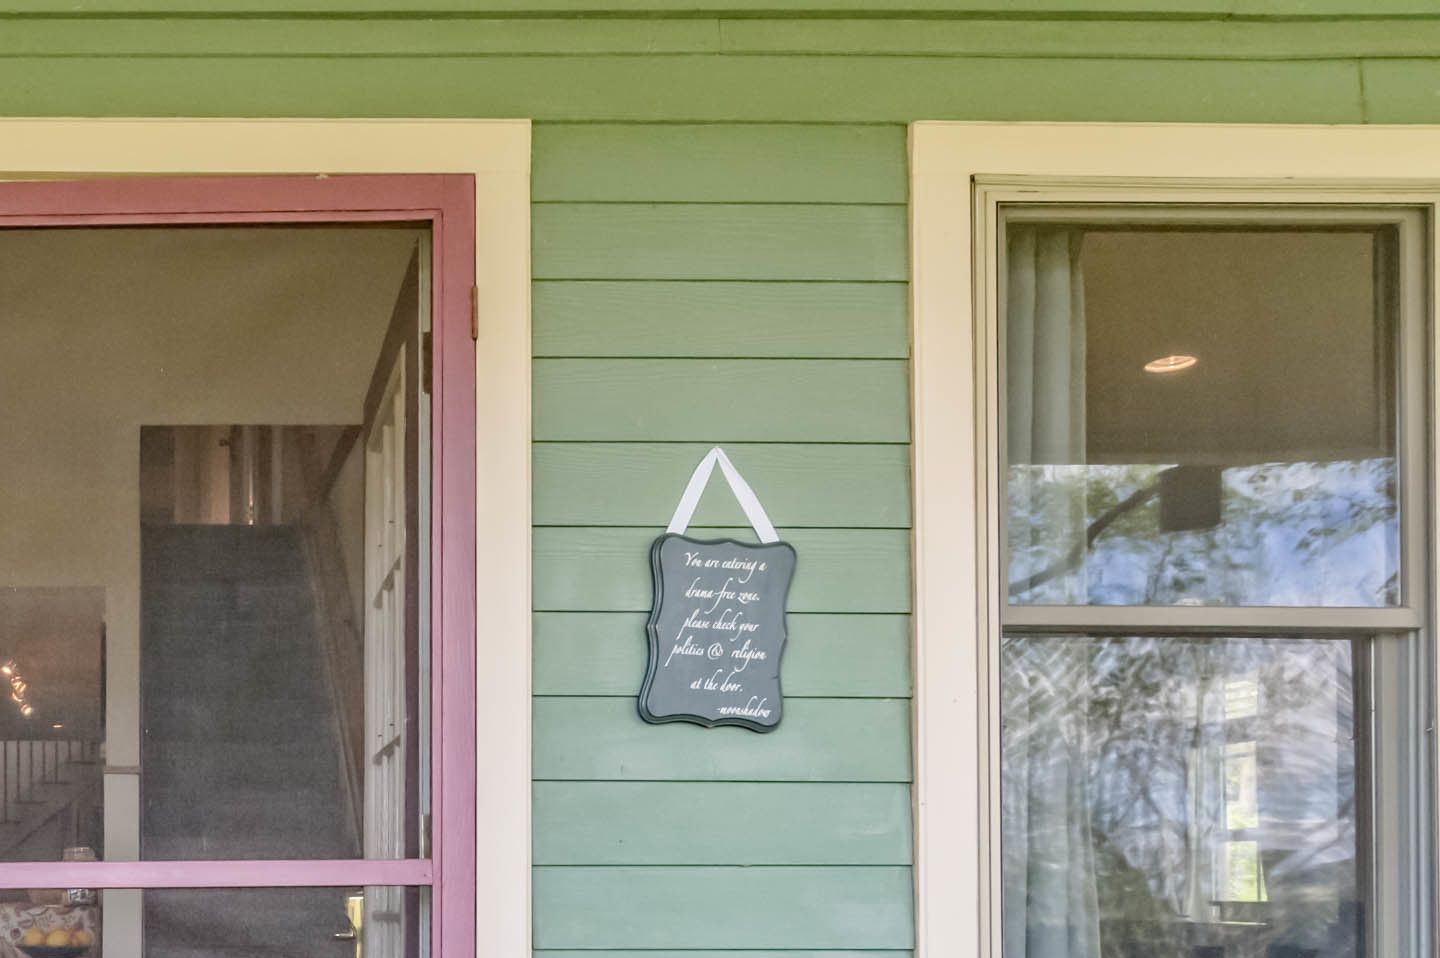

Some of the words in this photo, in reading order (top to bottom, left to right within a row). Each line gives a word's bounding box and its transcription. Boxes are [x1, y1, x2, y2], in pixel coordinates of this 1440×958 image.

[684, 552, 702, 567] You
[704, 560, 720, 568] are
[721, 558, 757, 583] entering
[759, 562, 768, 571] a
[685, 577, 736, 614] drama-free
[738, 592, 760, 604] zone.
[676, 608, 710, 639] please
[712, 608, 743, 630] check
[729, 623, 759, 641] your
[664, 635, 704, 667] politics
[707, 642, 724, 660] &
[731, 640, 767, 672] religion
[690, 677, 703, 690] at
[704, 669, 723, 690] the
[719, 671, 743, 692] door.
